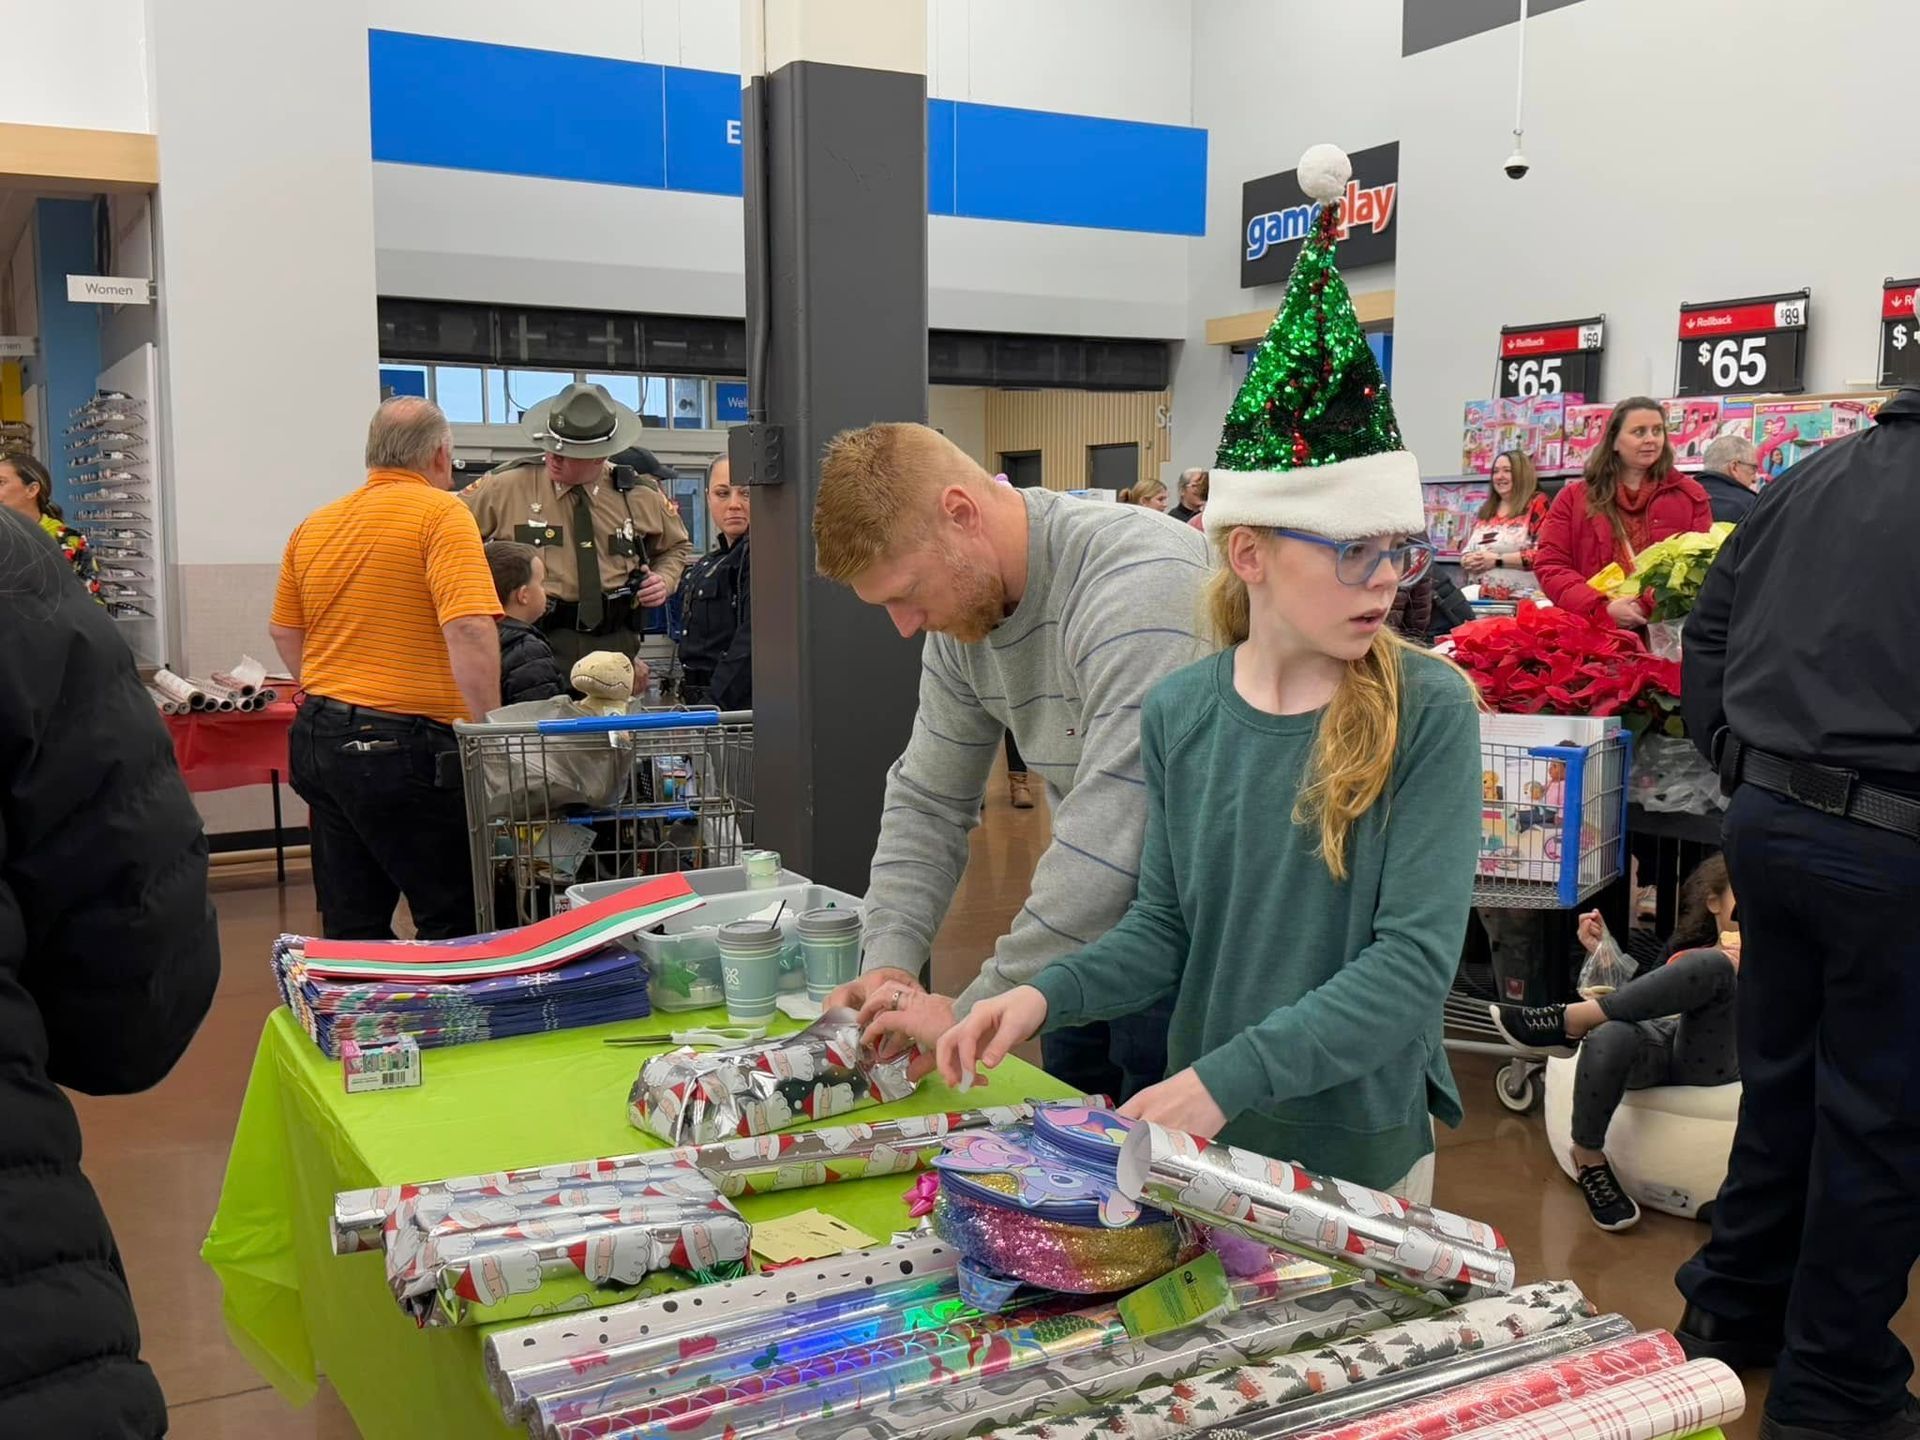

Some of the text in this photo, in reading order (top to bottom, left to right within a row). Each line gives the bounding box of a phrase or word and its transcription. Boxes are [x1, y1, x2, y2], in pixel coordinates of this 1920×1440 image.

[85, 282, 134, 296] Women
[1696, 307, 1800, 328] Rollback $89
[1697, 336, 1767, 388] $65
[1507, 358, 1562, 397] $65
